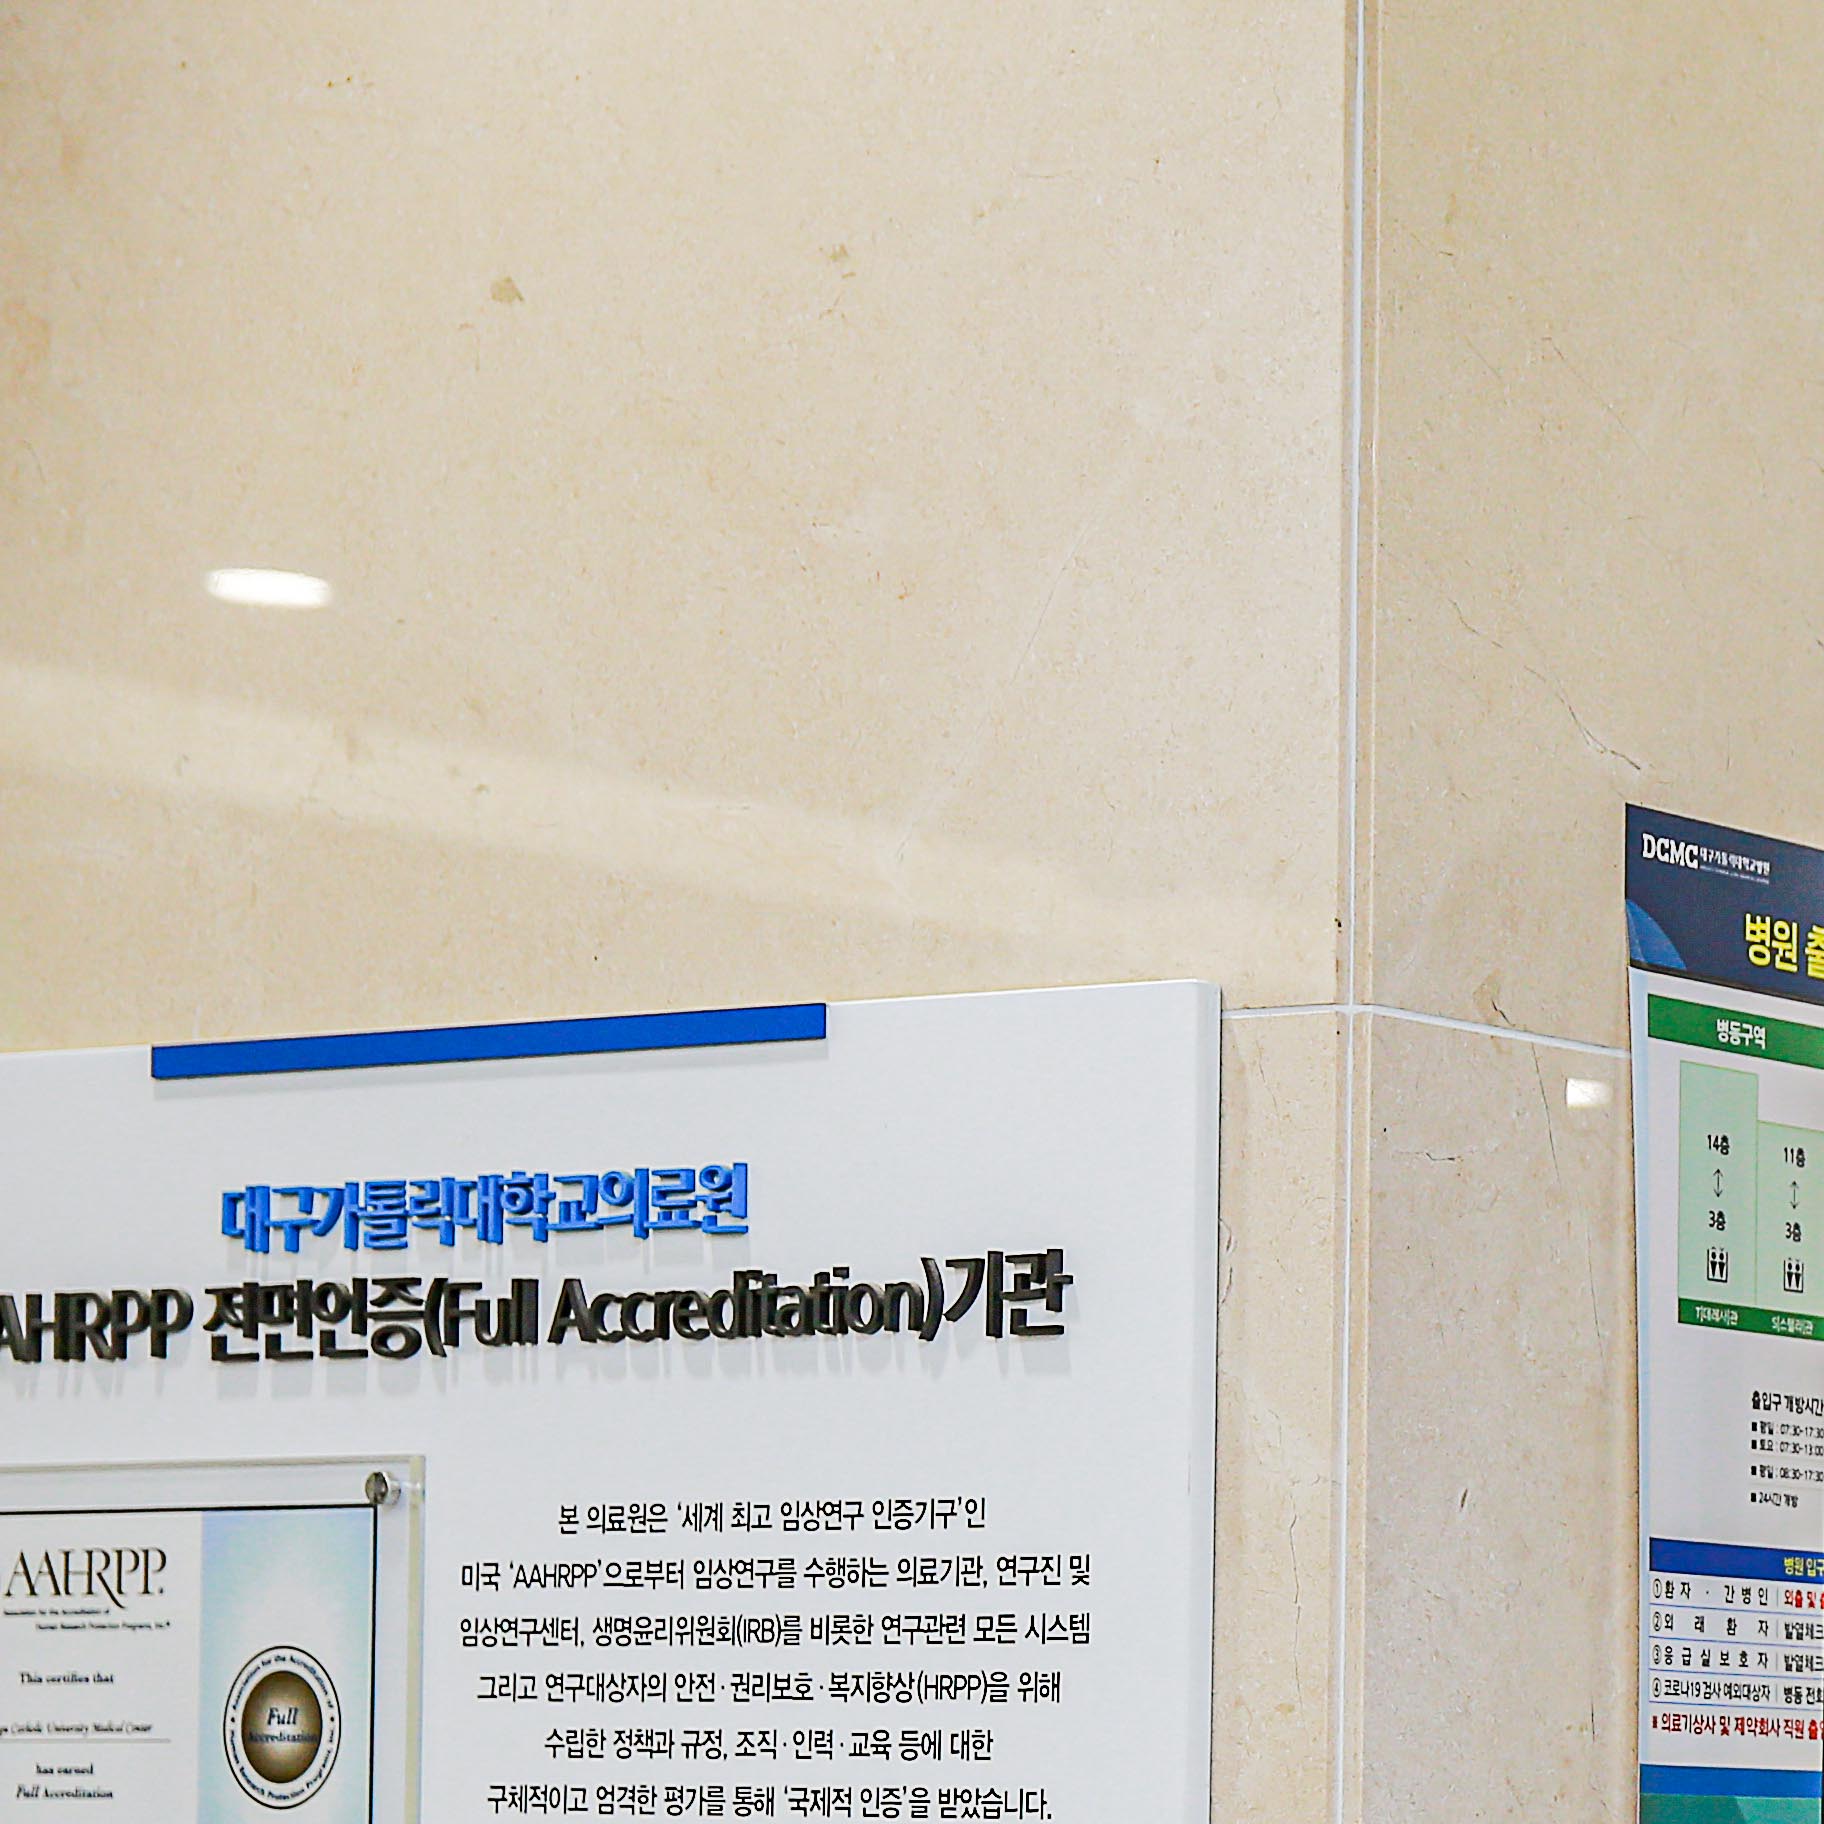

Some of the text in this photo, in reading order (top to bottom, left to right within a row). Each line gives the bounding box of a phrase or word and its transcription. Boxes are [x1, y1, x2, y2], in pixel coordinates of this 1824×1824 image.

[1642, 833, 1698, 869] DCMC
[1745, 913, 1798, 973] 병원
[1716, 1019, 1766, 1050] 병동구역
[1707, 1134, 1730, 1156] 14층
[1783, 1146, 1806, 1168] 11층
[221, 1162, 750, 1255] 대구가톨릭대학교의료원
[1708, 1210, 1727, 1232] 3층
[1785, 1221, 1802, 1243] 3층
[201, 1271, 540, 1362] 전면인증(Full
[547, 1246, 1075, 1349] Accreditation)기관
[1752, 1390, 1824, 1417] 출입구 개방시간
[558, 1504, 580, 1535] 본
[586, 1503, 669, 1535] 의료원은
[730, 1501, 773, 1533] 최고
[780, 1499, 865, 1532] 임상연구
[461, 1561, 501, 1592] 미국
[693, 1557, 798, 1590] 임상연구를
[803, 1556, 890, 1589] 수행하는
[896, 1555, 988, 1589] 의료기관,
[996, 1554, 1061, 1587] 연구진
[1069, 1553, 1090, 1586] 및
[460, 1612, 1090, 1648] 임상연구센터, 생명윤리위원회(IRB)를 비롯한 연구관련 모든 시스템
[476, 1672, 538, 1703] 그리고
[545, 1672, 667, 1704] 연구대상자의
[1017, 1671, 1061, 1704] 위해
[267, 1707, 299, 1725] Full
[1661, 1712, 1804, 1740] 의료기상사 및 제약회사 직원
[544, 1728, 607, 1759] 수립한
[612, 1728, 676, 1760] 정책과
[680, 1728, 728, 1761] 규정,
[898, 1729, 942, 1762] 등에
[950, 1729, 994, 1762] 대한
[487, 1784, 589, 1815] 구체적이고
[596, 1784, 658, 1816] 엄격한
[663, 1785, 726, 1817] 평가를
[732, 1786, 775, 1818] 통해
[938, 1787, 1052, 1821] 받았습니다.
